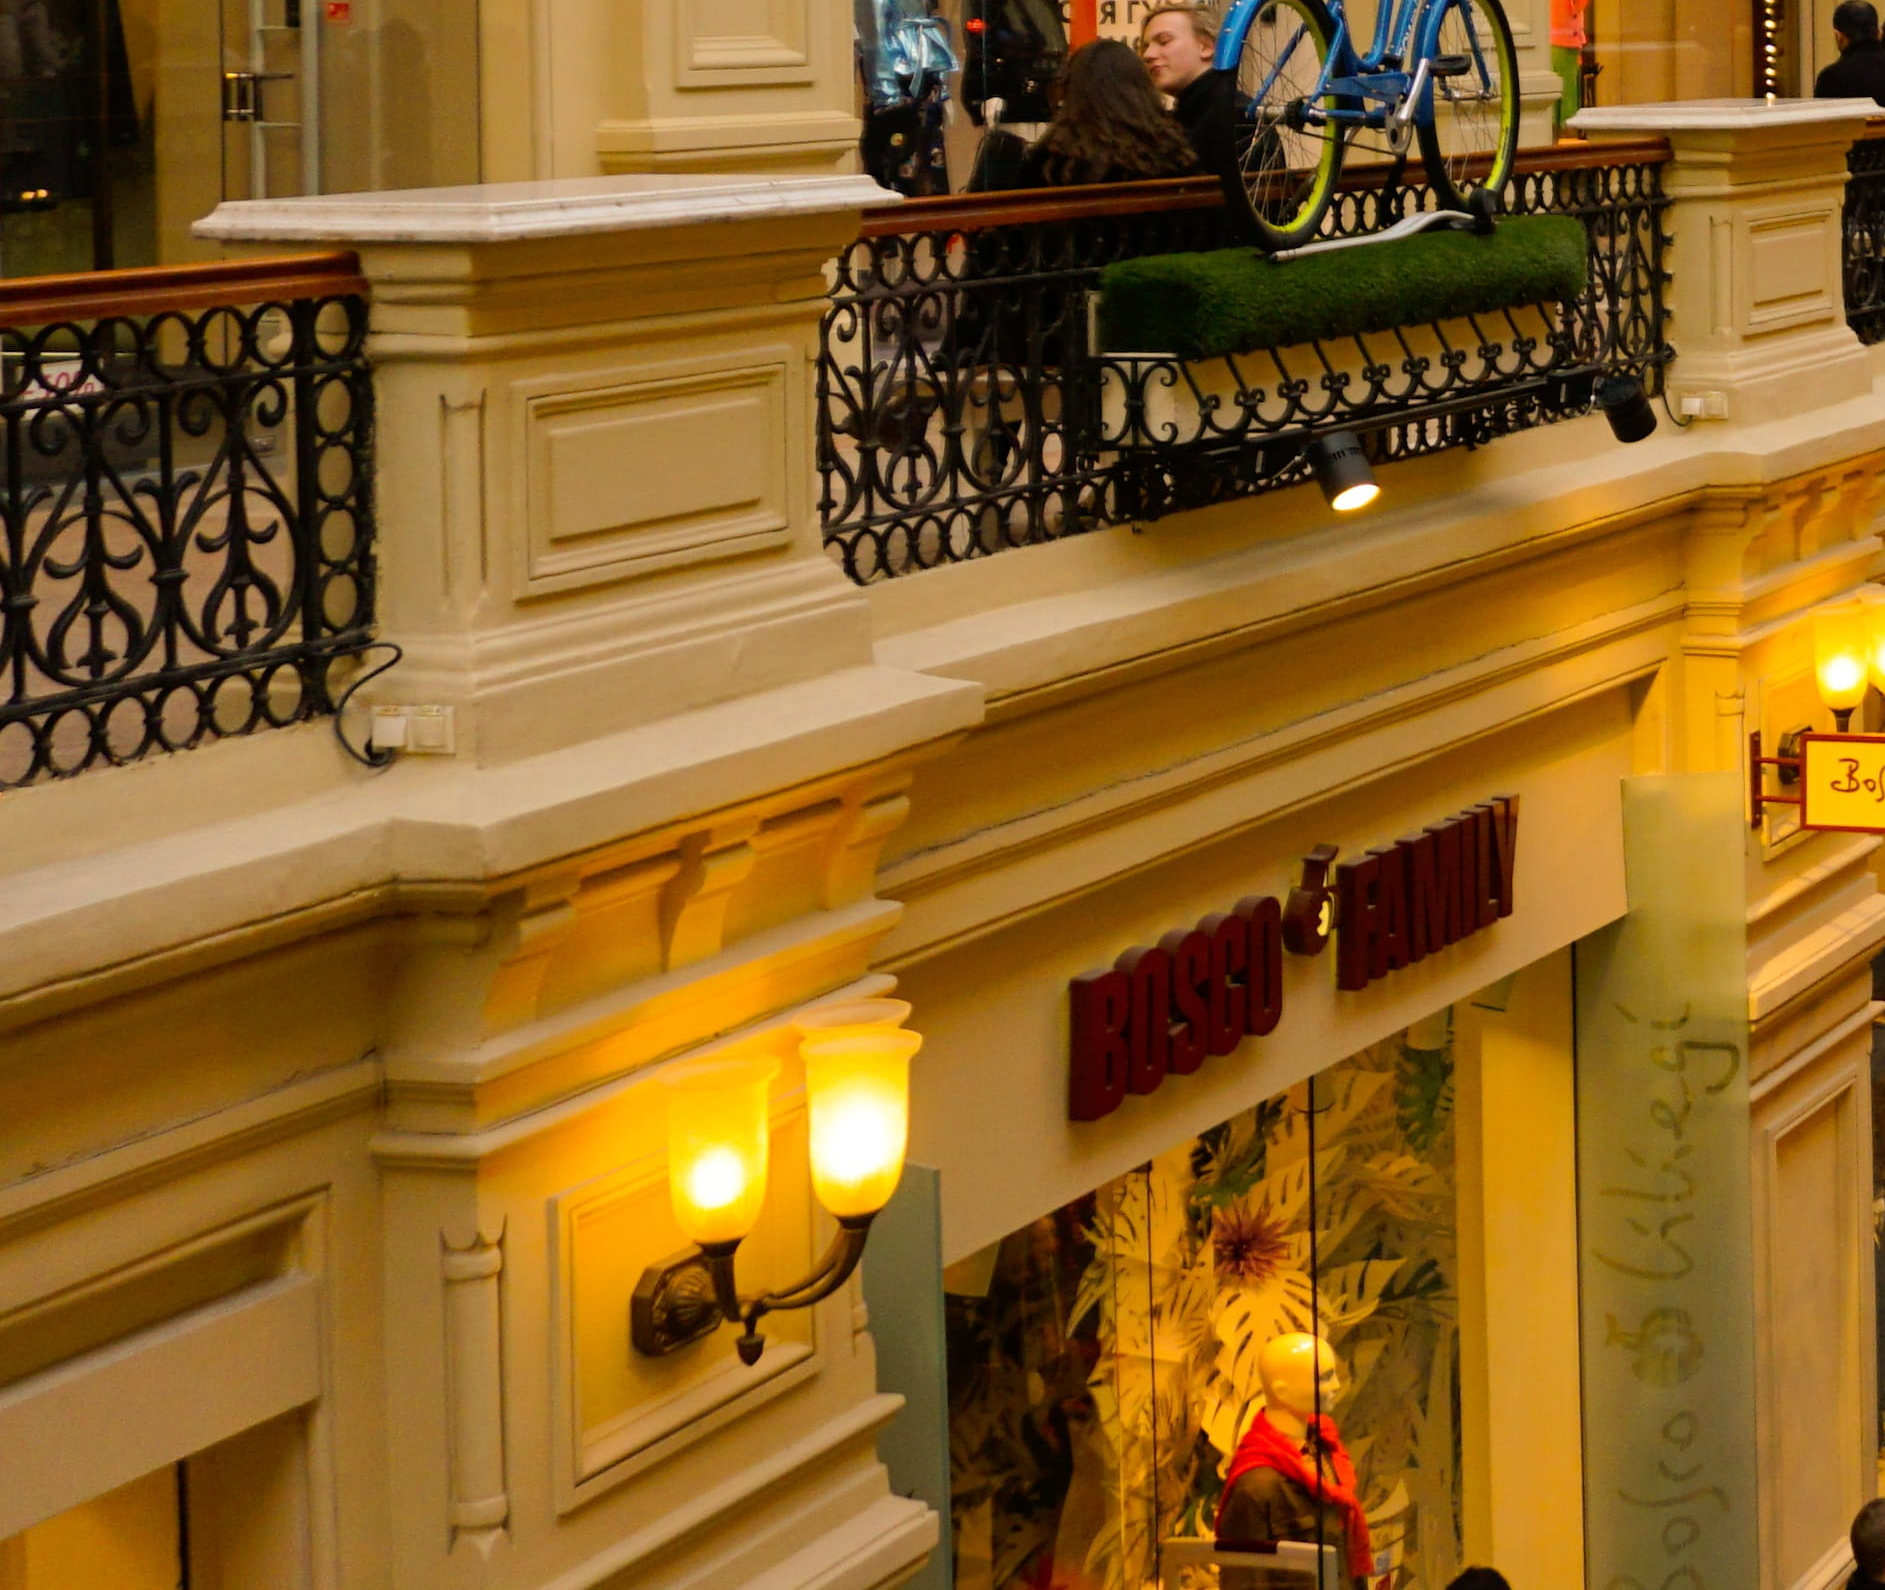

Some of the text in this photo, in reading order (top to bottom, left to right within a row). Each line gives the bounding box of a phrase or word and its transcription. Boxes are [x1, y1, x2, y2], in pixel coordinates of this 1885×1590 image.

[1069, 794, 1520, 1122] BOSCO FAMILY
[1605, 1410, 1731, 1590] osco
